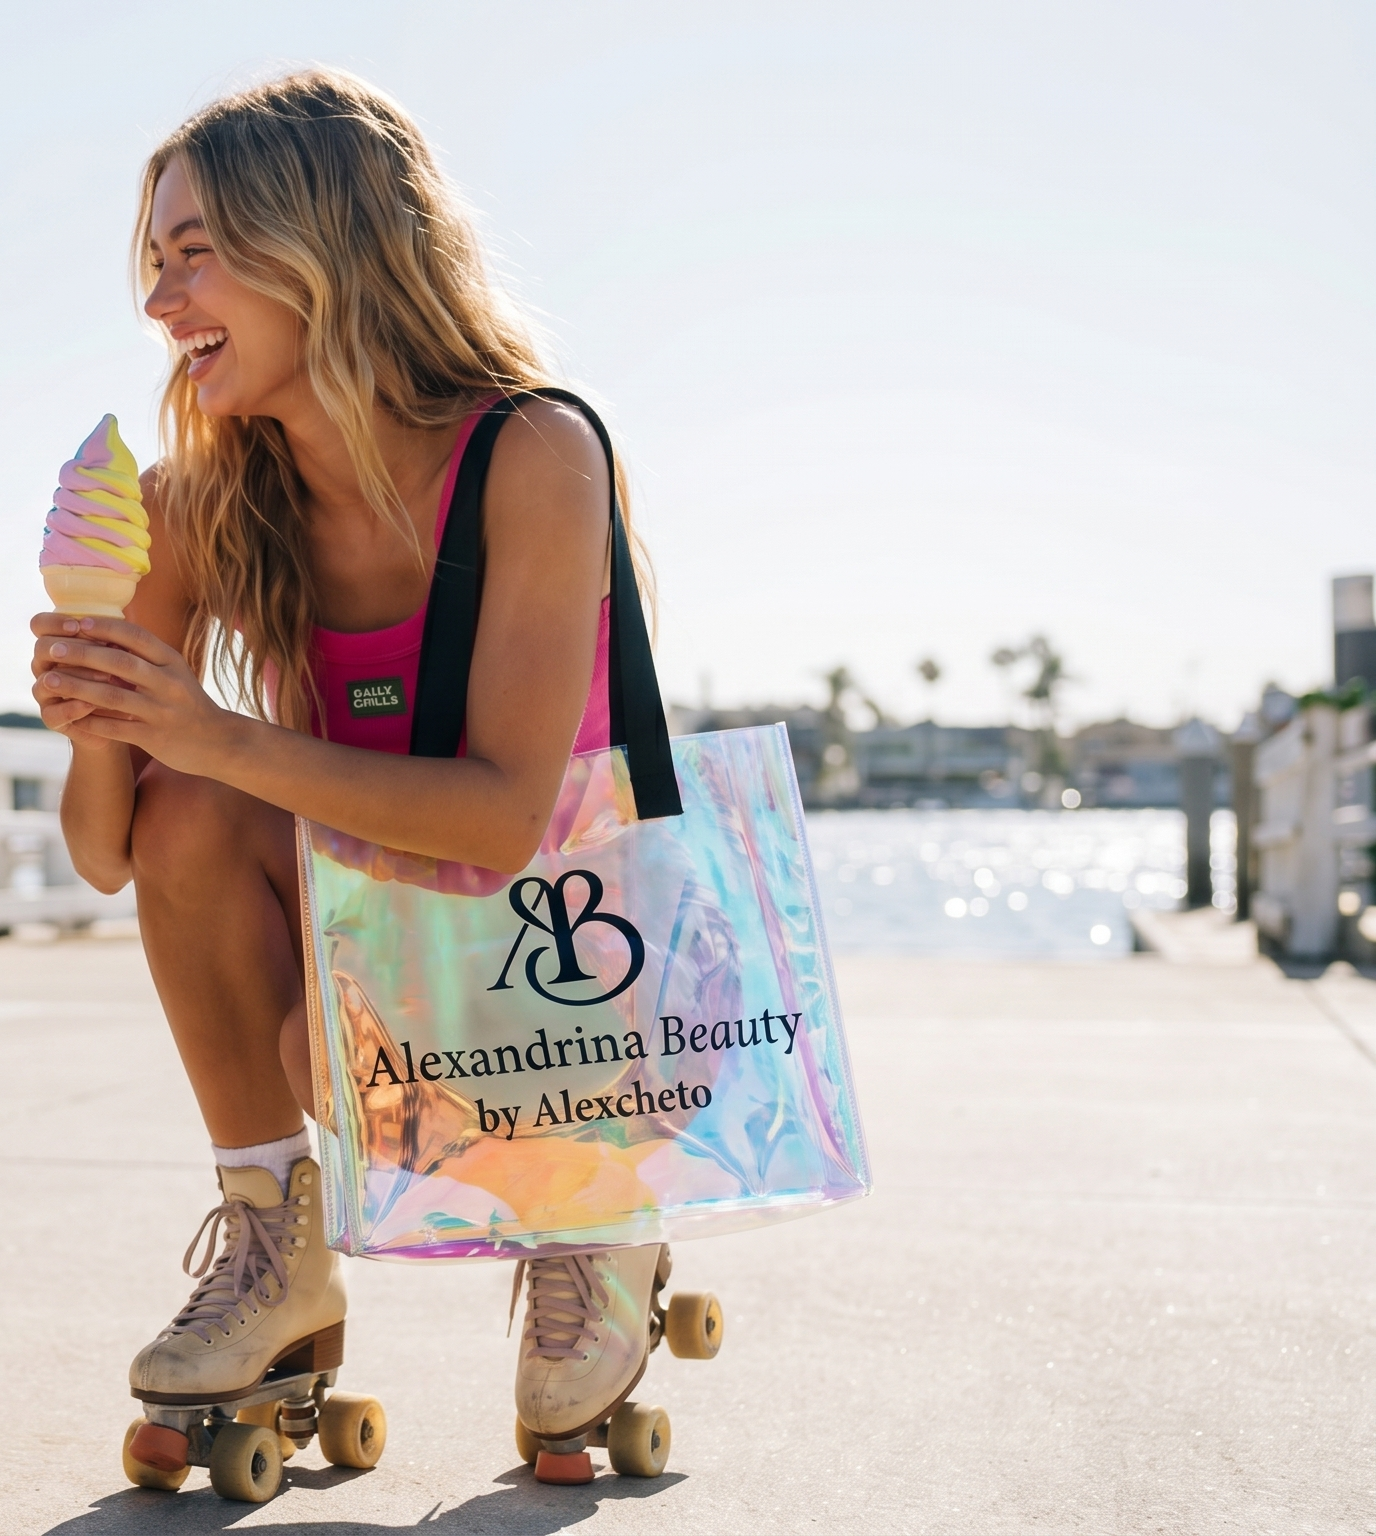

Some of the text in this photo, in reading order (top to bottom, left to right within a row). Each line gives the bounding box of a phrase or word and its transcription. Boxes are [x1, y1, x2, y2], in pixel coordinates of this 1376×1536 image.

[365, 1007, 804, 1088] Alexandrina Beauty
[474, 1079, 713, 1142] by Alexcheto
